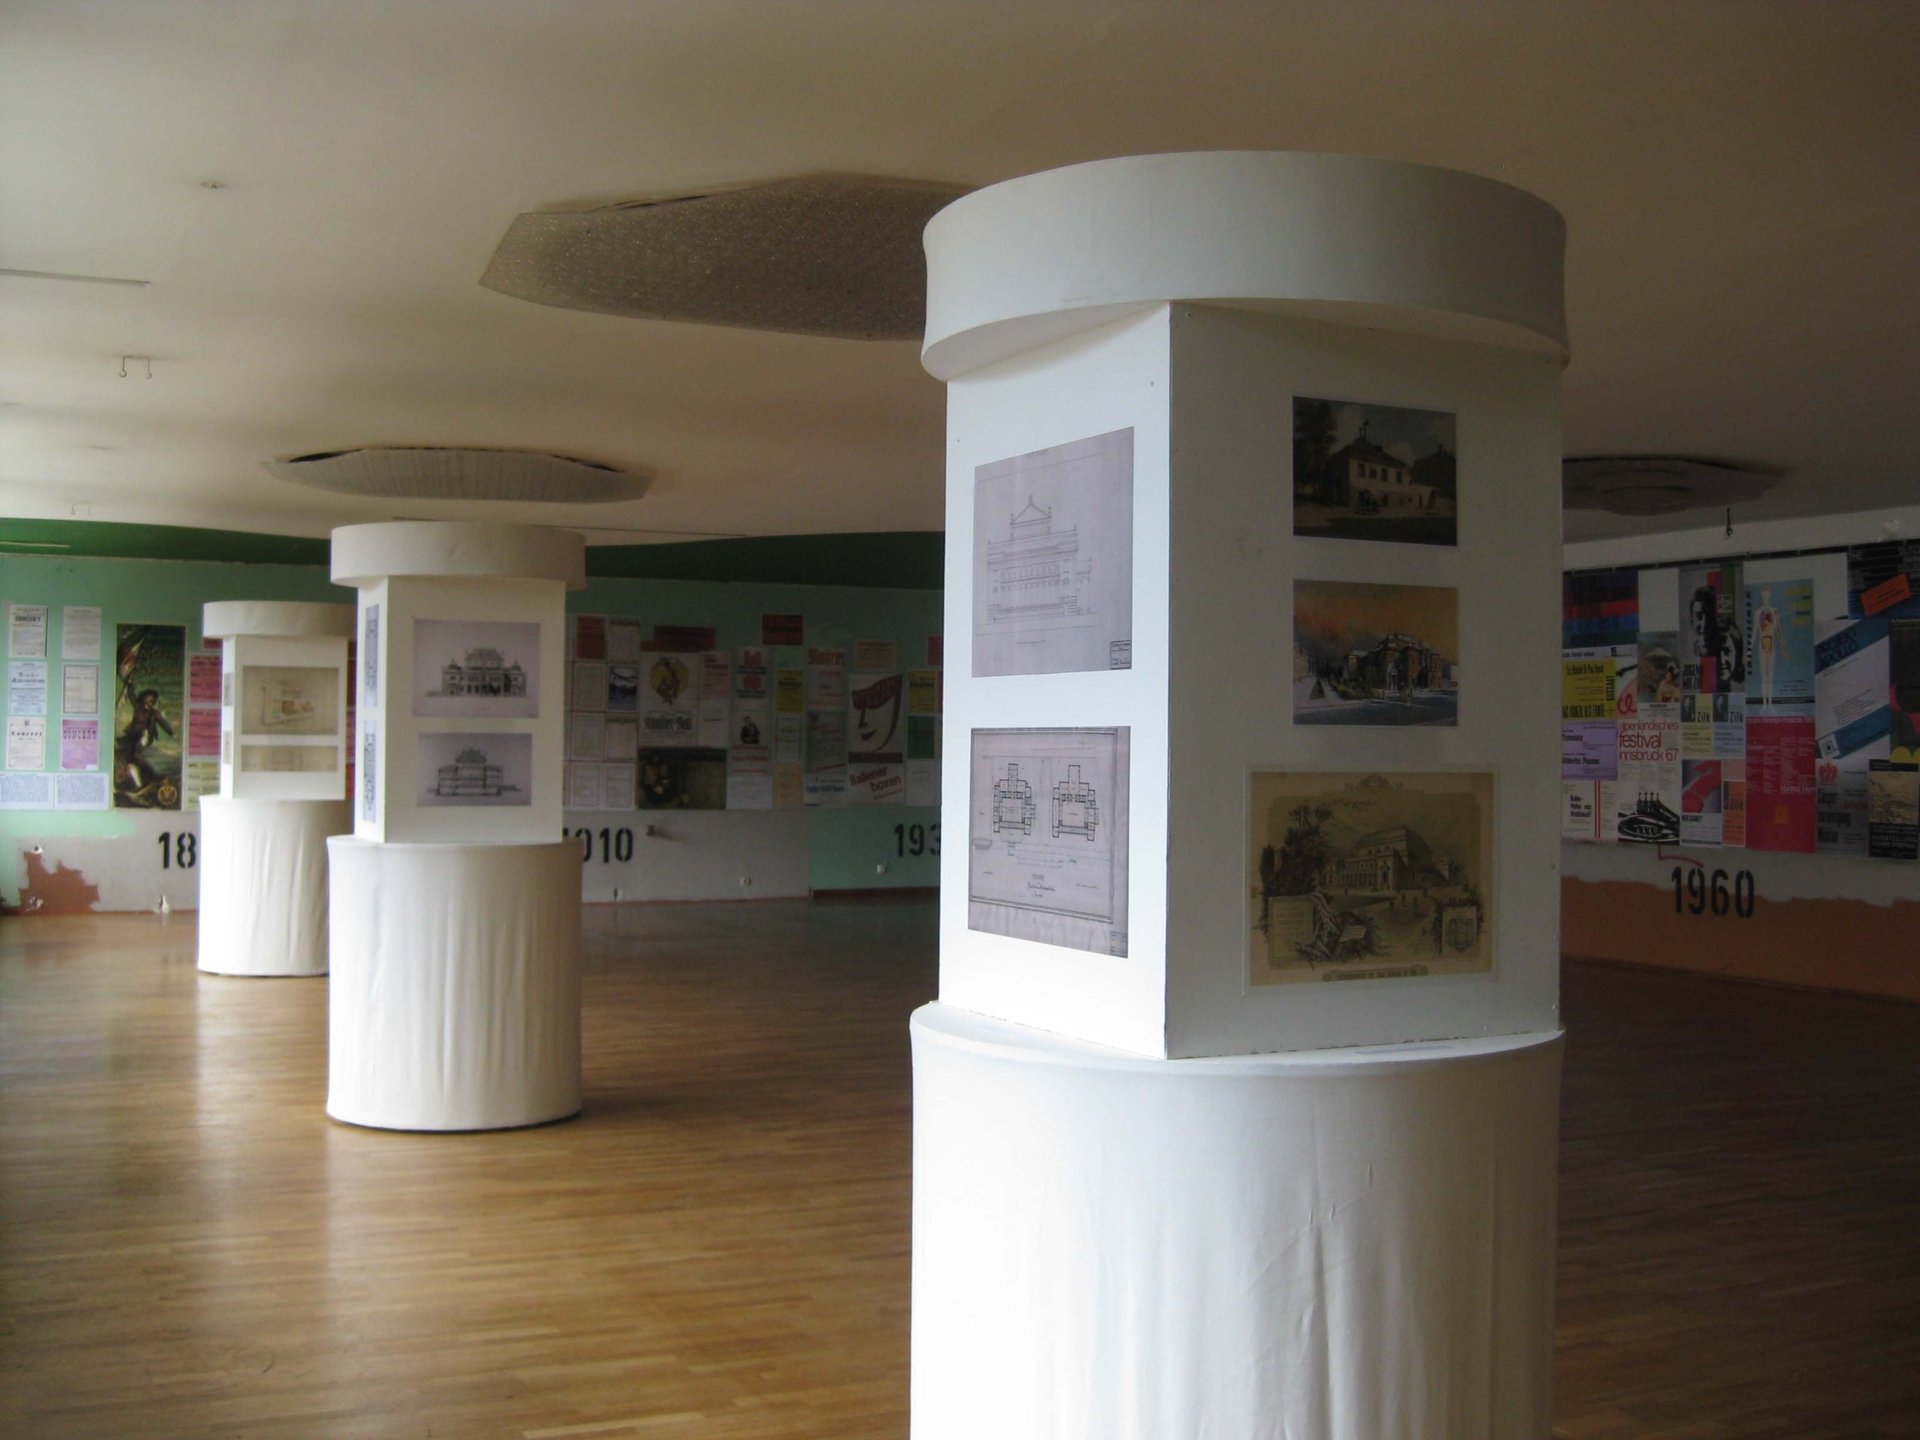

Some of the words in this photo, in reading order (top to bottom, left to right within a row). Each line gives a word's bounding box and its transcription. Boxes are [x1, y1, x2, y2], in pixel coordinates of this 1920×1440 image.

[1617, 720, 1679, 732] alpenländisches
[1619, 731, 1662, 748] festival
[1618, 748, 1664, 761] innsbruck
[1665, 748, 1679, 761] 67
[849, 766, 888, 787] Italiener
[870, 775, 901, 793] boxen
[158, 831, 197, 869] 18
[1671, 866, 1755, 918] 1960
